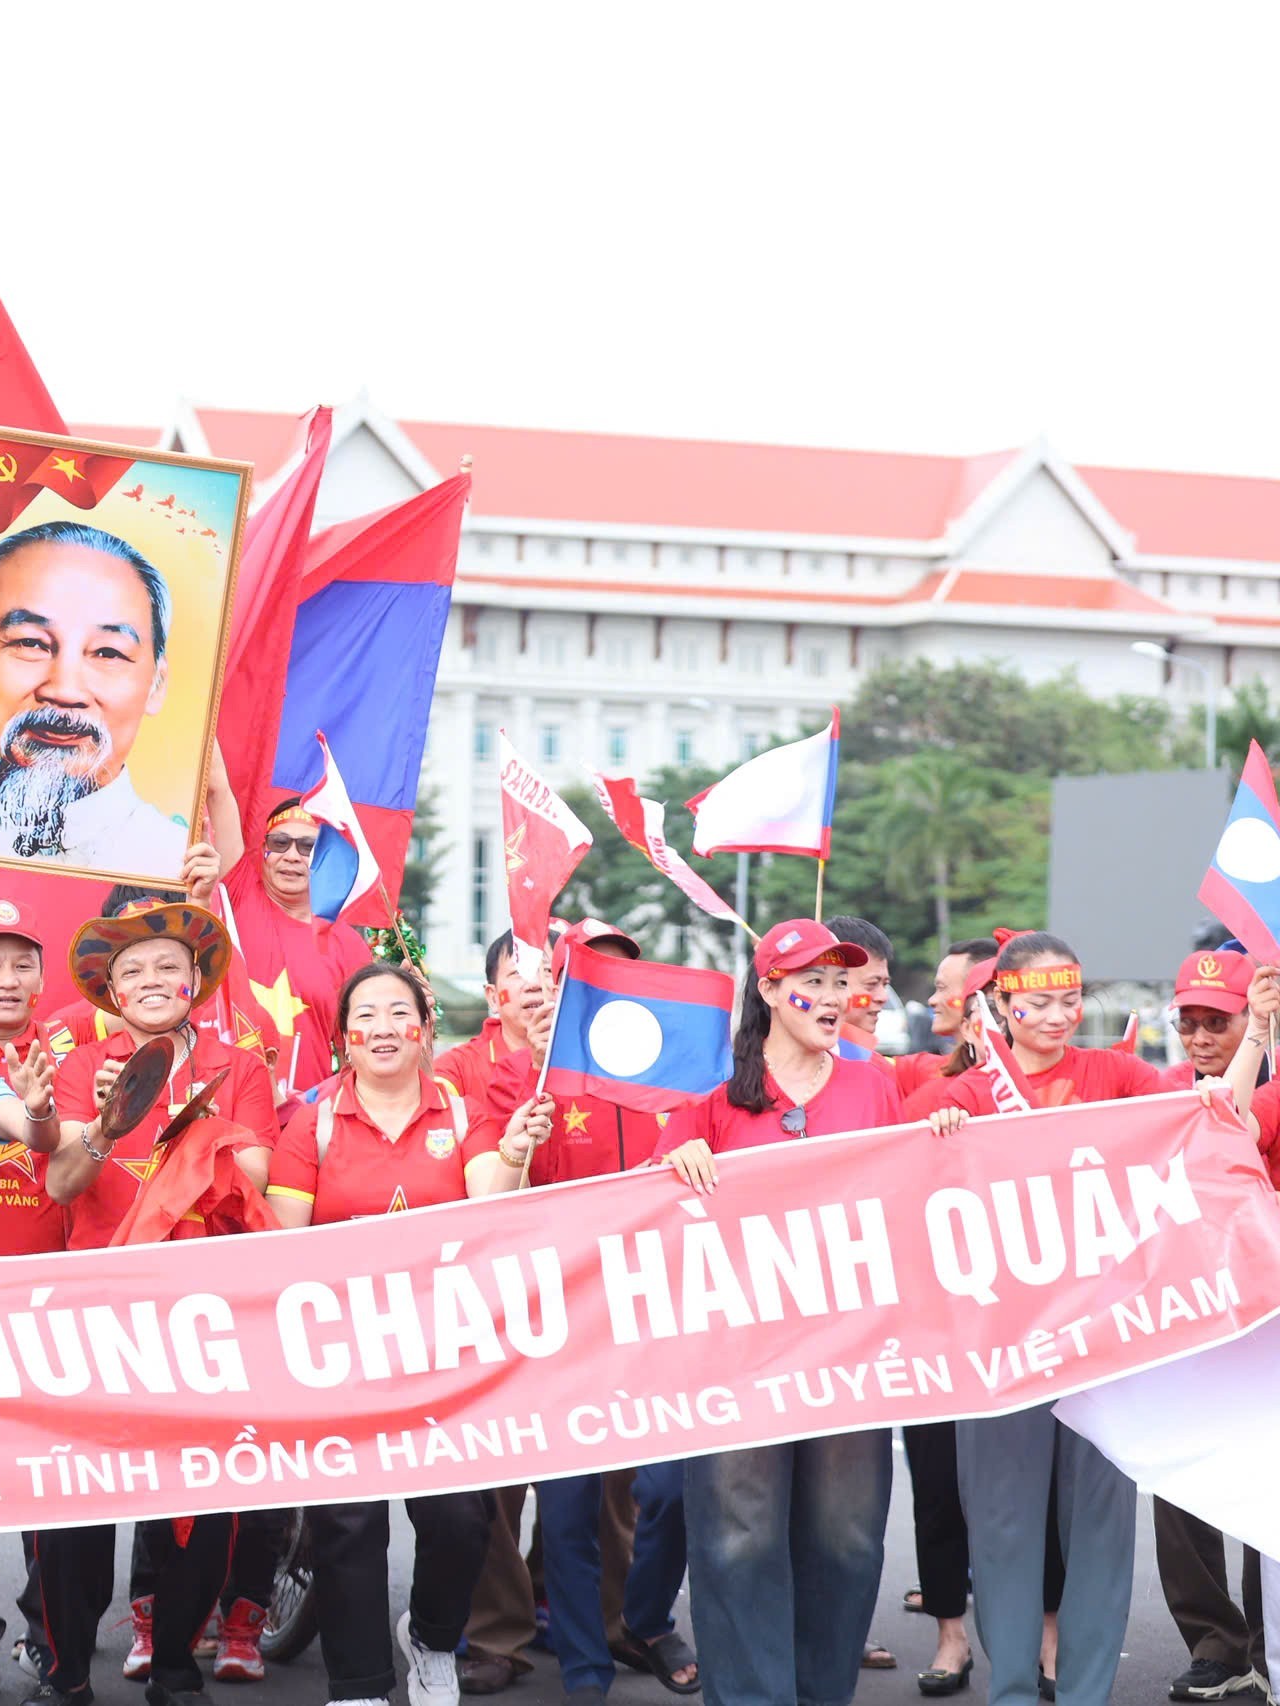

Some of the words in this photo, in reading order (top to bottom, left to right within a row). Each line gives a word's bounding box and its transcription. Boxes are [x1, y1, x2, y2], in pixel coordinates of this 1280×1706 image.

[1003, 973, 1019, 990] TÔI
[1021, 971, 1047, 989] YÊU
[1050, 968, 1076, 989] VIỆT
[0, 1178, 20, 1191] BIA
[5, 1192, 39, 1207] VÀNG
[275, 1240, 569, 1388] CHÁU
[598, 1198, 900, 1345] HÀNH
[925, 1146, 1202, 1306] QUÂN
[16, 1444, 160, 1498] TĨNH
[179, 1424, 359, 1488] ĐỒNG
[376, 1413, 549, 1471] HÀNH
[567, 1385, 742, 1445] CÙNG
[754, 1338, 953, 1414] TUYỂN
[966, 1315, 1093, 1390] VIỆT
[1110, 1267, 1241, 1344] NAM
